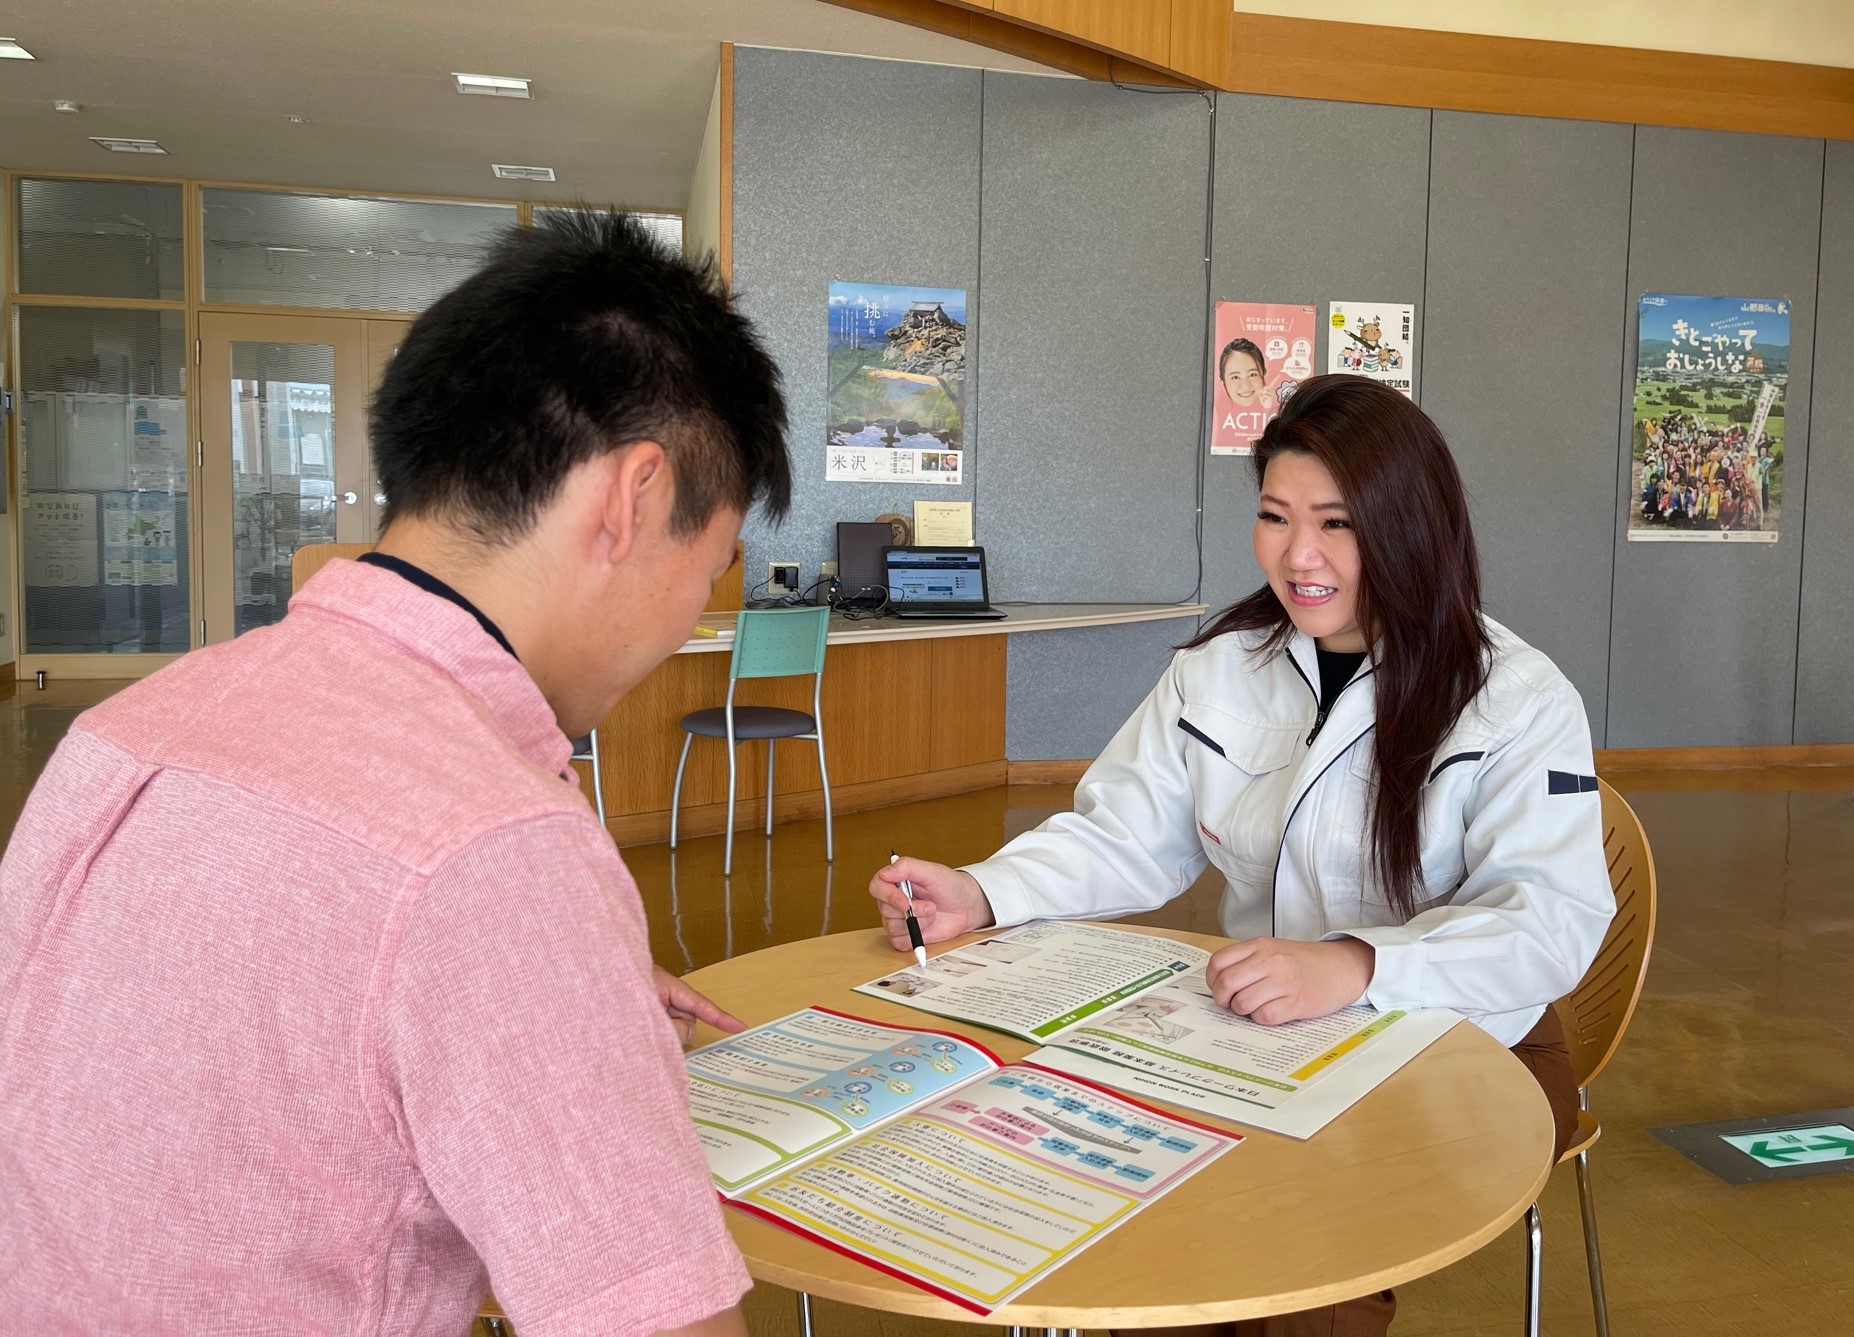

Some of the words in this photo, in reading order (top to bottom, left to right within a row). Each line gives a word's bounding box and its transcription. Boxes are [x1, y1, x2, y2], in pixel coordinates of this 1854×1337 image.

[864, 302, 881, 338] 挑む旅。
[1666, 349, 1744, 373] おしょうしな
[831, 454, 867, 472] 米沢
[1133, 1077, 1157, 1086] NIHON
[1158, 1083, 1179, 1092] WORK
[1181, 1089, 1206, 1099] PLACE
[1159, 1064, 1260, 1097] 日本ワークプレイス
[871, 1143, 962, 1183] 社会保険加入について
[827, 1166, 949, 1219] 自動車・バイク通勤について
[789, 1186, 903, 1238] お友だち紹介制度について
